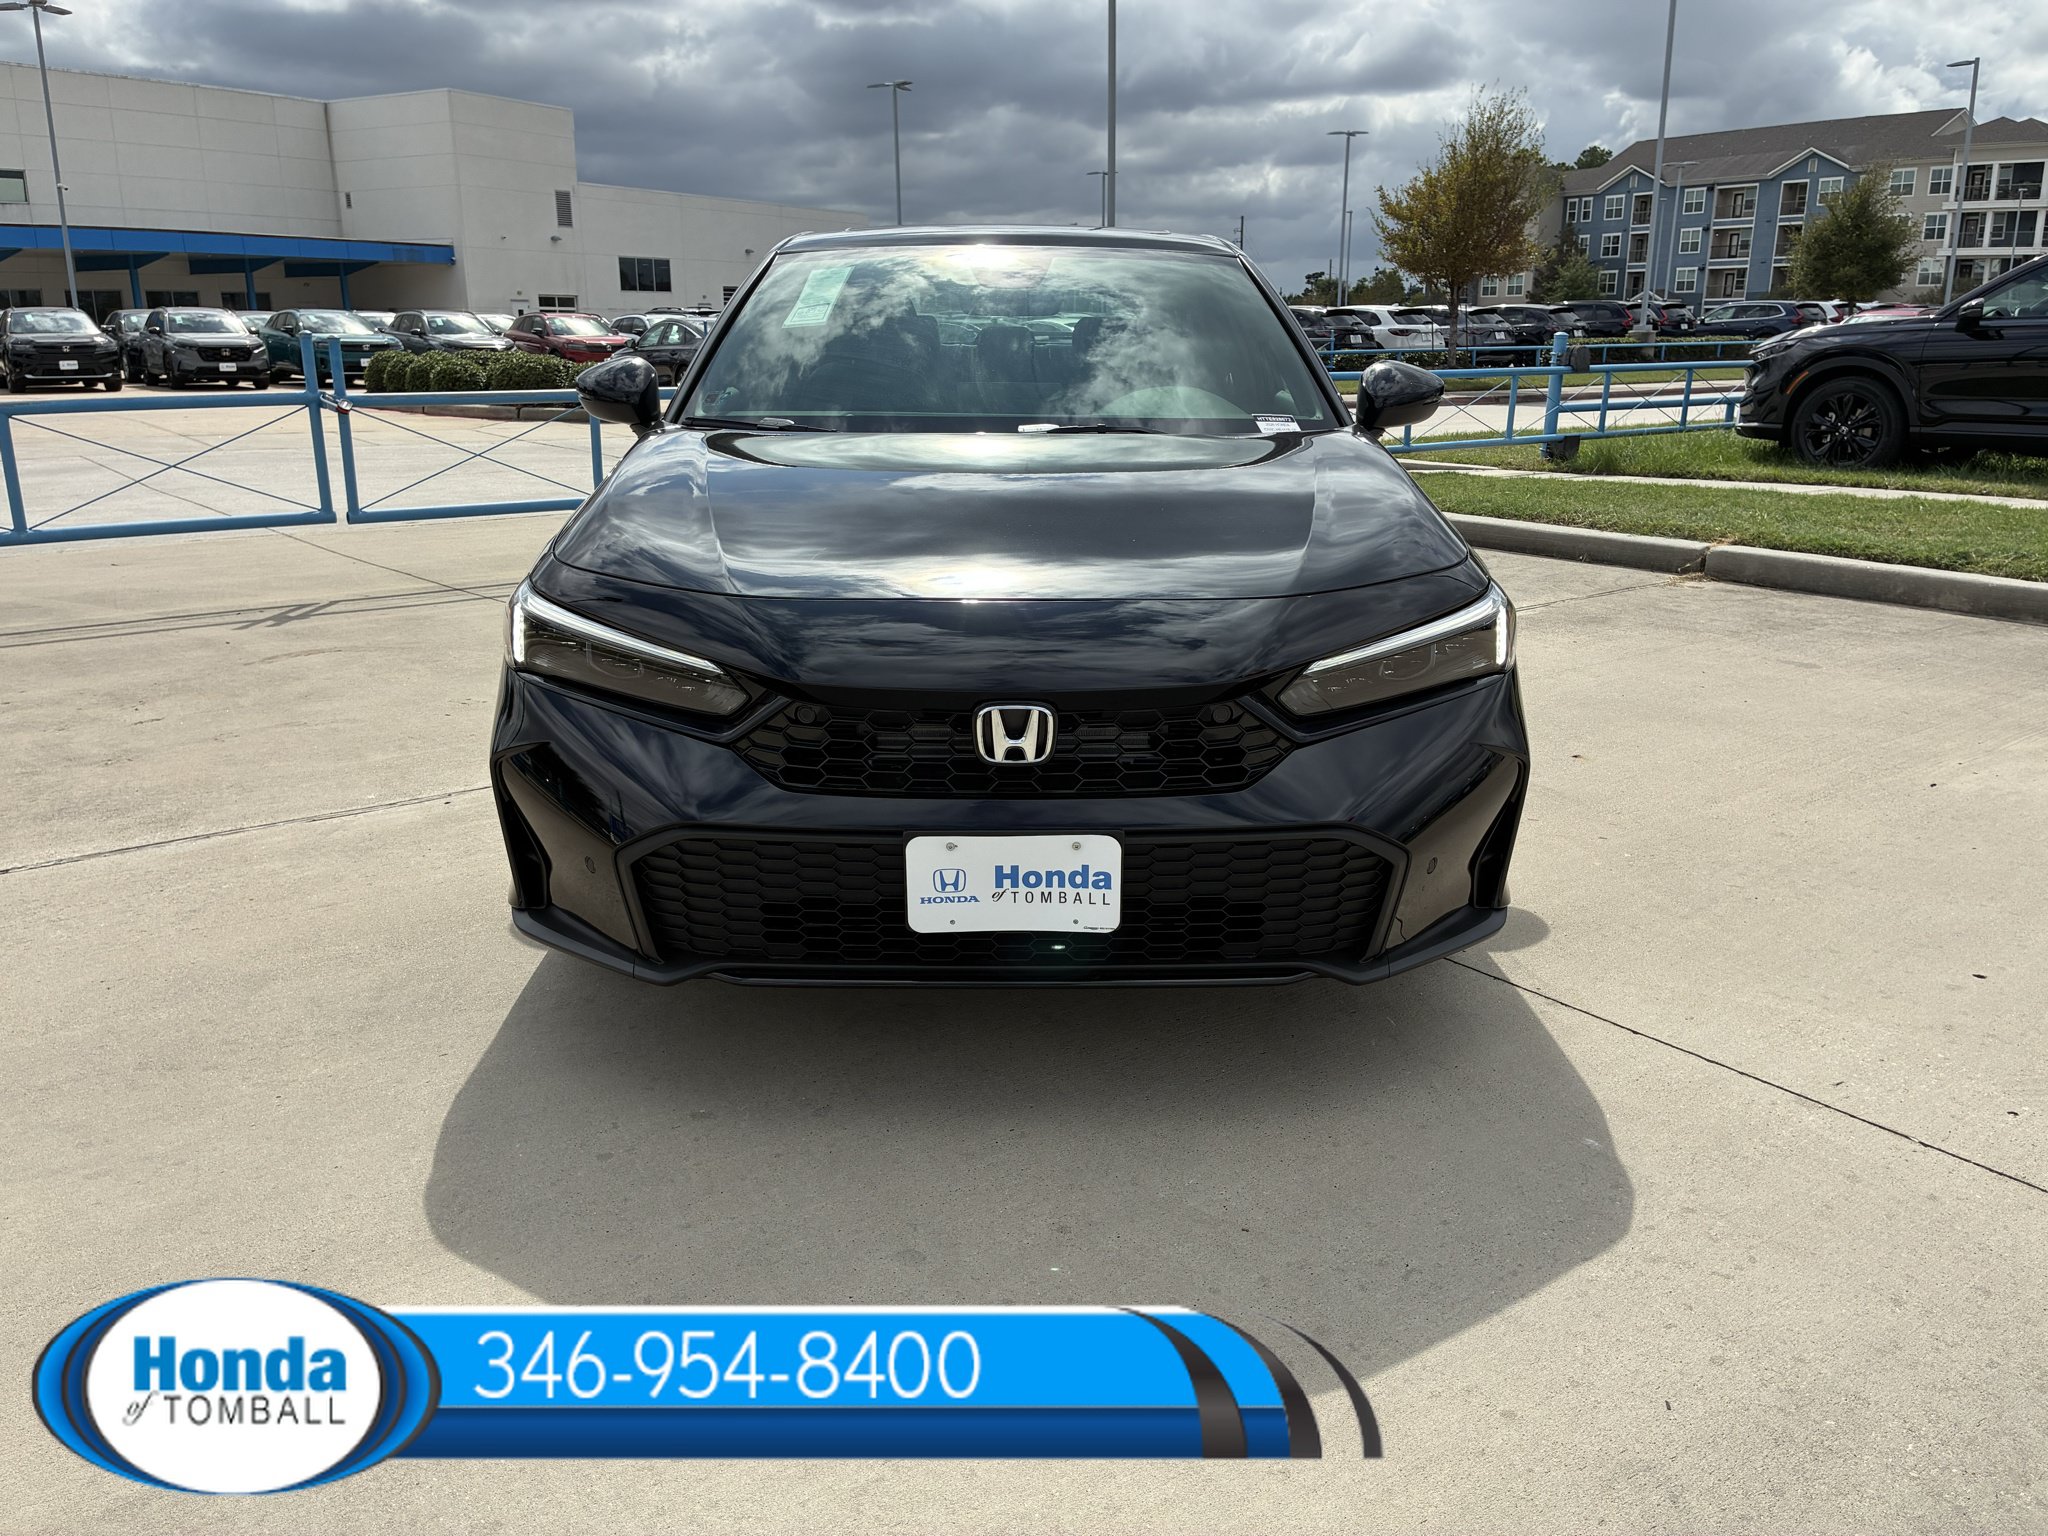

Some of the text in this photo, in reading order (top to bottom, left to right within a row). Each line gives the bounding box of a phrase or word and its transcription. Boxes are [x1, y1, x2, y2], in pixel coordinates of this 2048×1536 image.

[995, 865, 1111, 889] Honda
[920, 896, 980, 904] HONDA
[992, 888, 1110, 905] of TOMBALL
